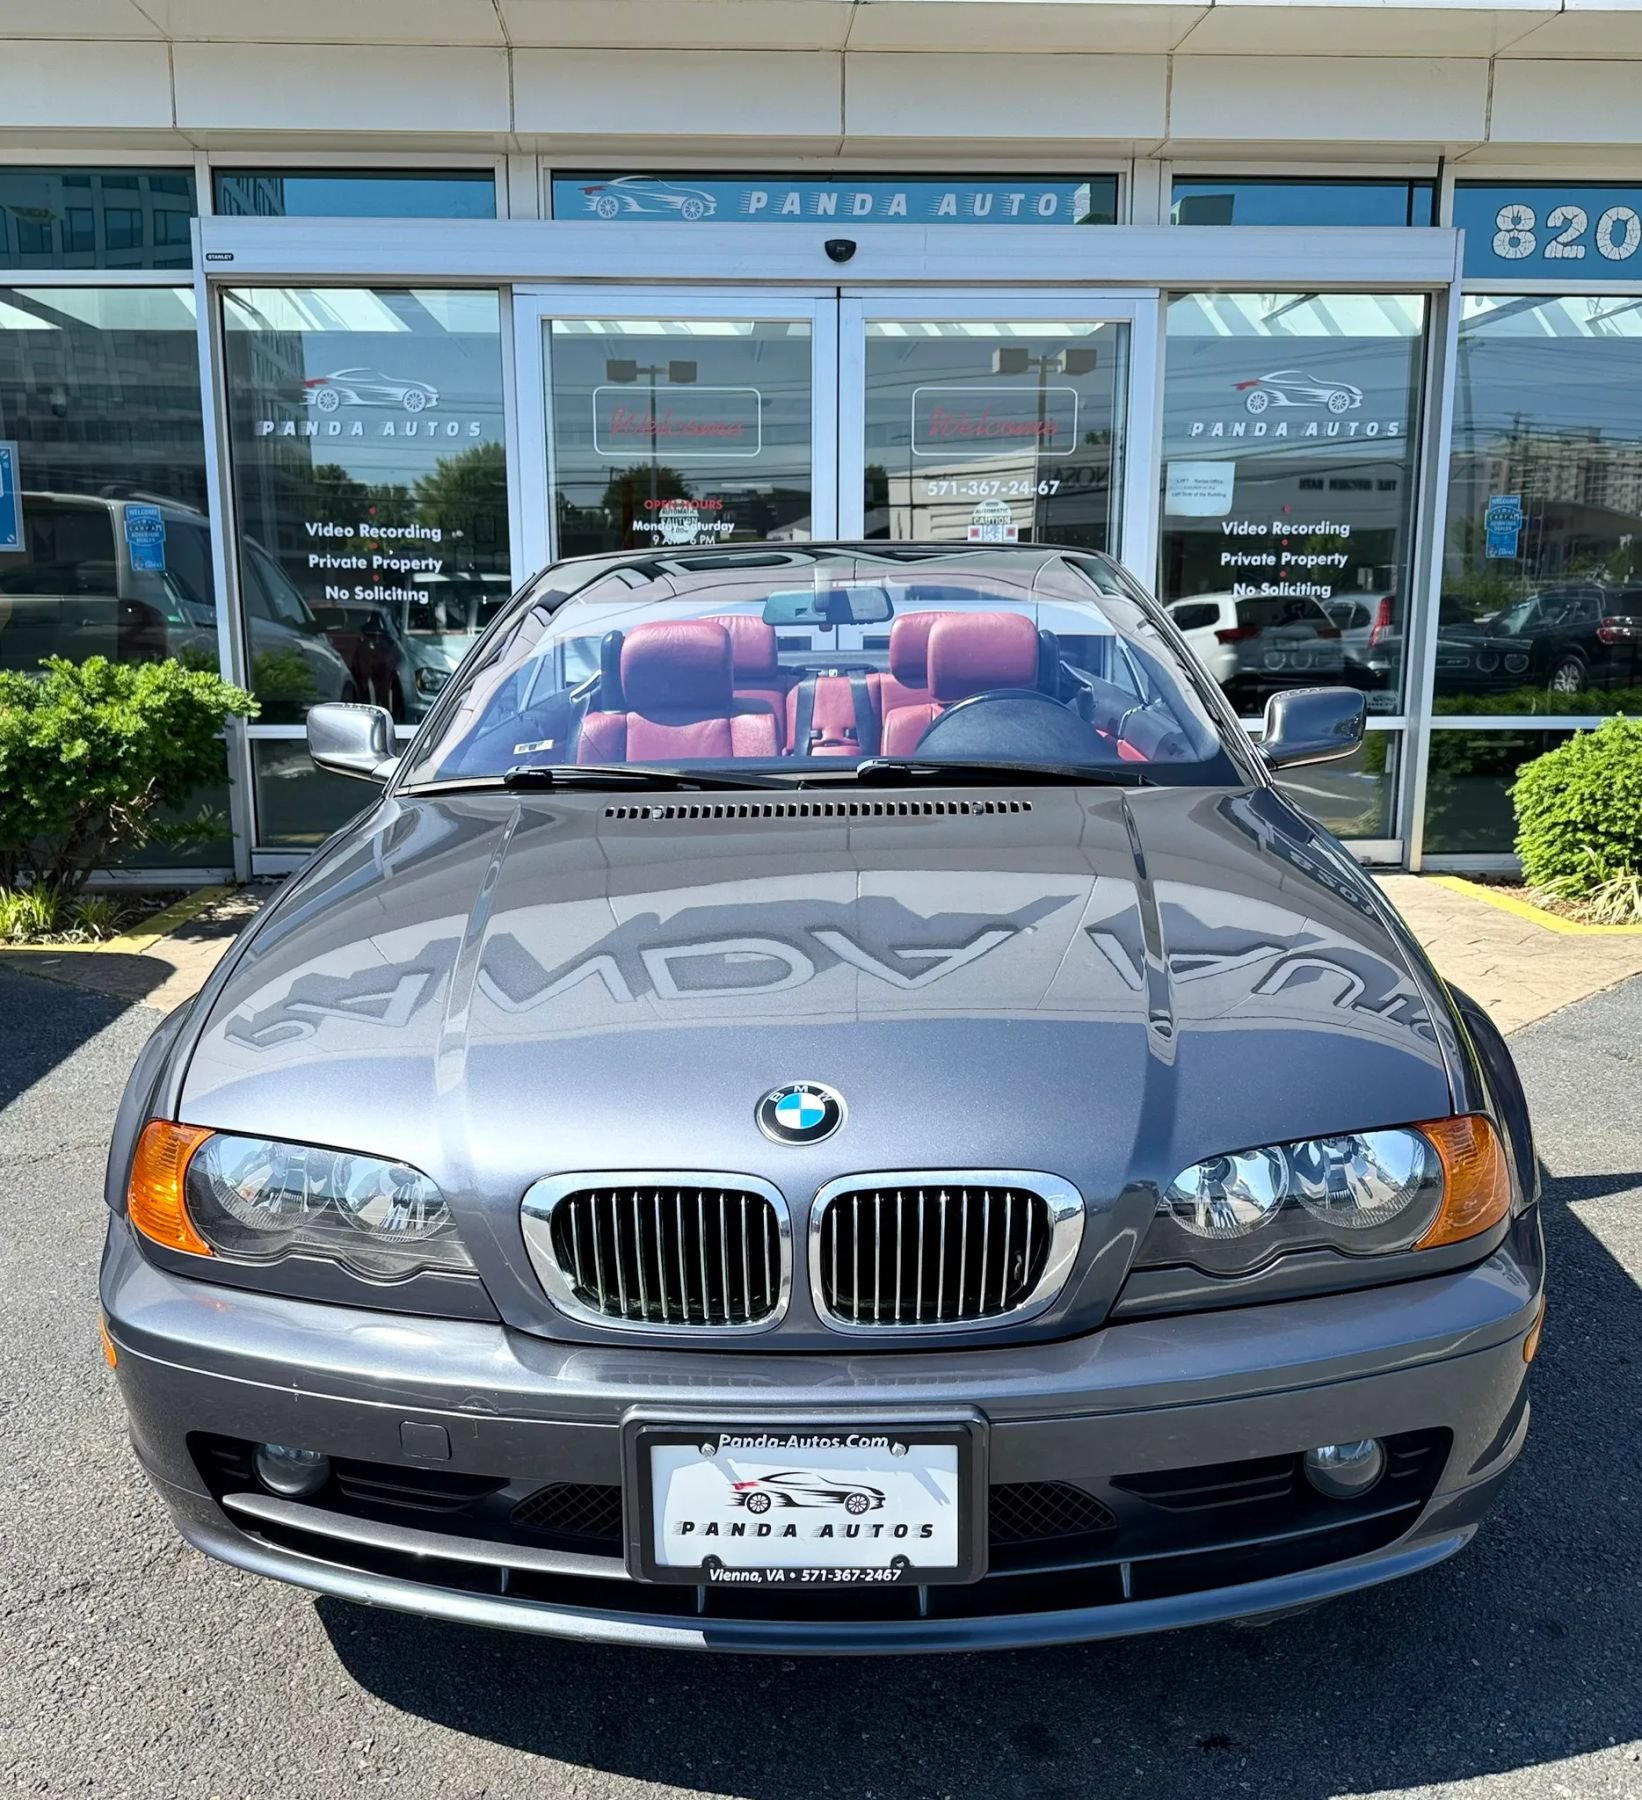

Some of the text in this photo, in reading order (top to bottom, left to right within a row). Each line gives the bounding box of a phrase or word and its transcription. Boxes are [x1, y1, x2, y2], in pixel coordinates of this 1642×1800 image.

[740, 190, 907, 216] PANDA
[1491, 203, 1642, 261] 820
[255, 420, 482, 438] PANDA AUTOS
[1187, 421, 1400, 438] PANDA AUTOS
[926, 480, 1061, 496] 571-367-24-67
[305, 521, 442, 543] Video Recording
[632, 520, 736, 534] Monday-Saturday
[1221, 520, 1351, 538] Video Recording
[699, 535, 716, 545] PM
[308, 553, 443, 573] Private Property
[1220, 551, 1349, 568] Private Property
[325, 584, 429, 605] No Soliciting
[1232, 581, 1333, 599] No Soliciting
[767, 1084, 835, 1102] BMW
[718, 1433, 889, 1450] Panda-Autos.Com
[674, 1521, 934, 1539] PANDA AUTOS
[708, 1568, 901, 1583] Vienna, VA 571-367-2467
